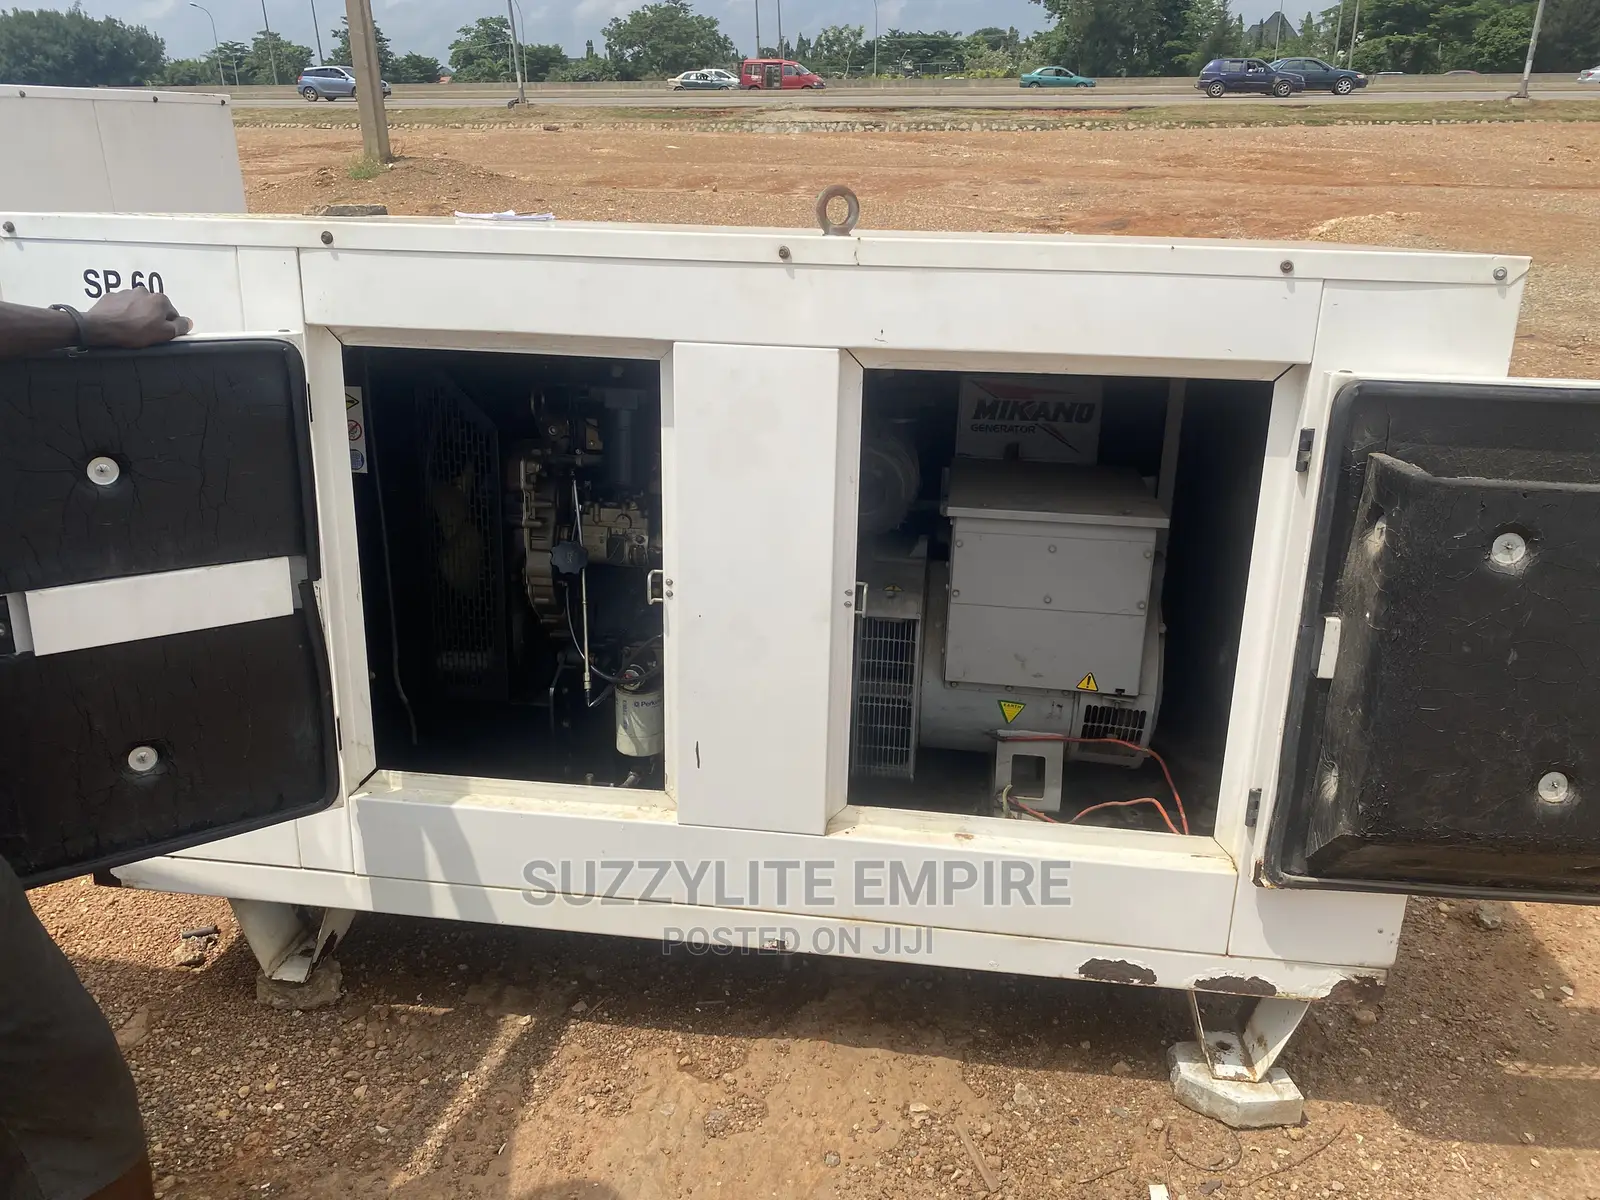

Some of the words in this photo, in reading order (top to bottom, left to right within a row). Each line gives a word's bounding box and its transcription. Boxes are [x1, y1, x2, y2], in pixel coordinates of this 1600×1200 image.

[83, 269, 121, 299] SP
[131, 271, 164, 294] 60
[971, 398, 1096, 424] MIKANO
[970, 424, 1036, 434] GENERATOR
